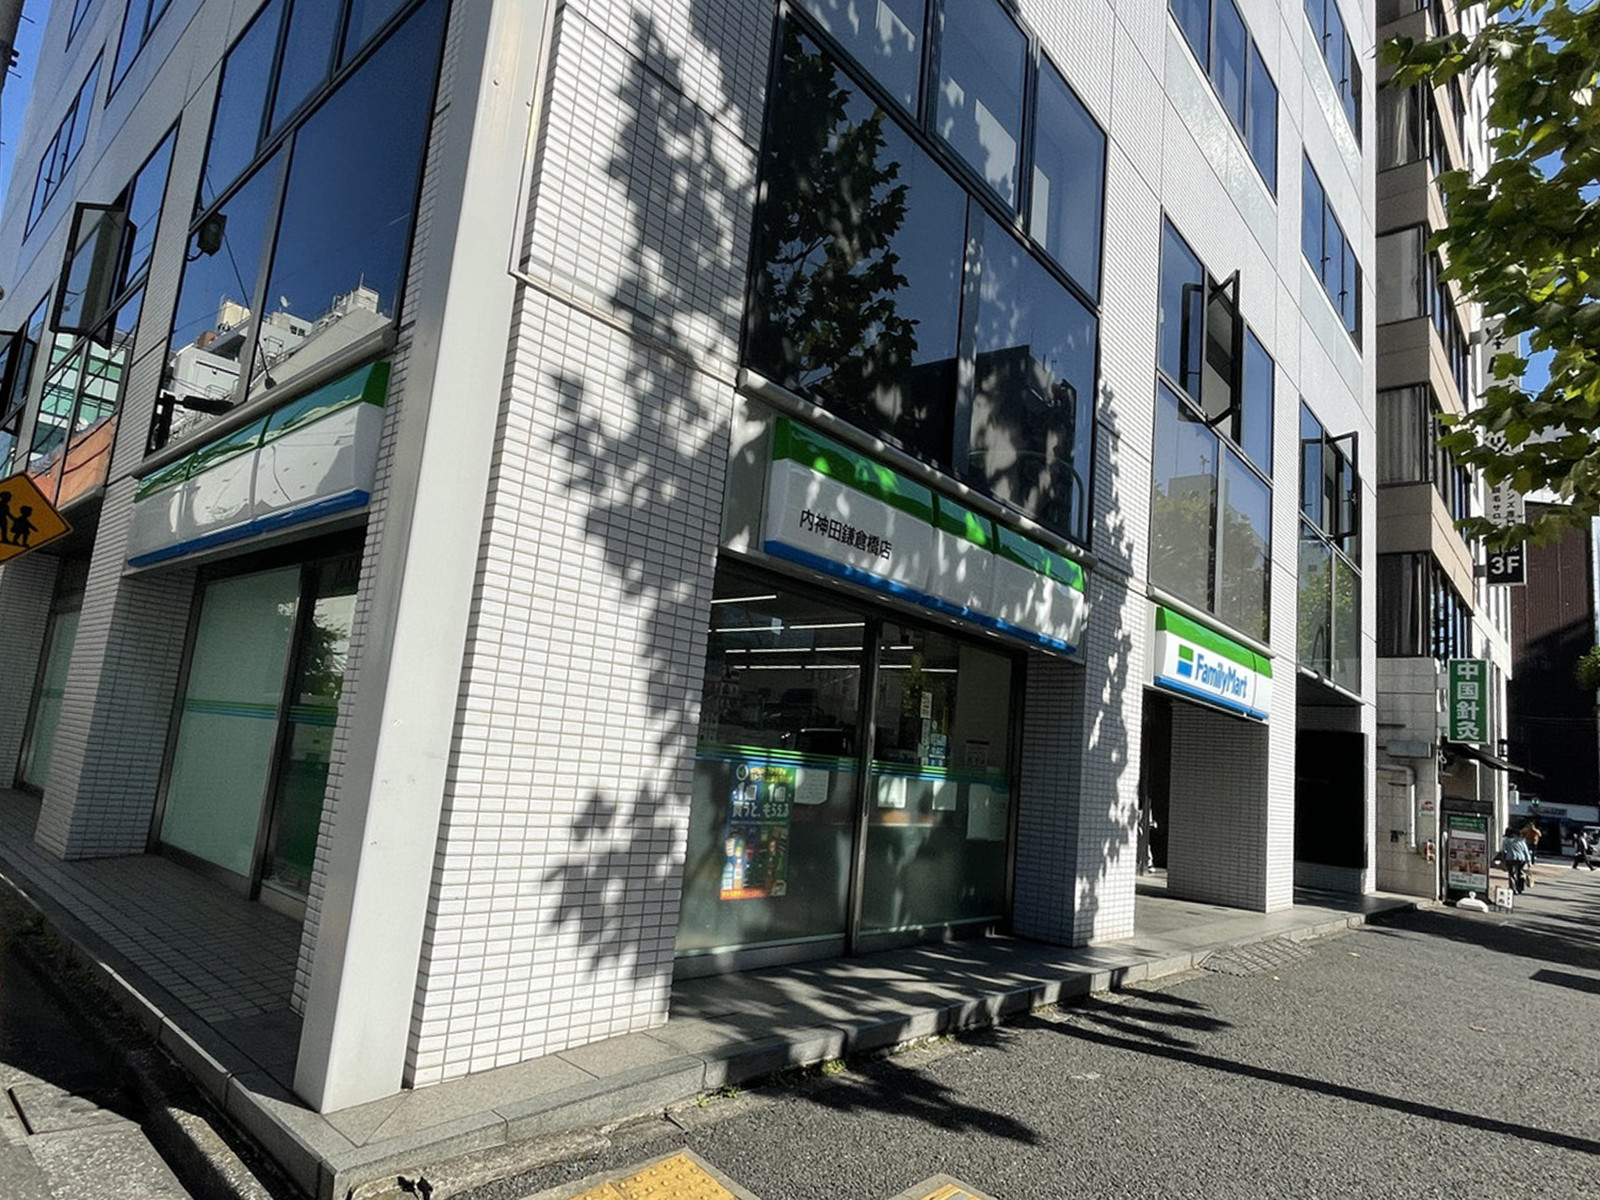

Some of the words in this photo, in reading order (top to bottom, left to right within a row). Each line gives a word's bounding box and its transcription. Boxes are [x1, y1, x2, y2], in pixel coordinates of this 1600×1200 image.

[799, 508, 892, 560] 内神田鎌倉橋店
[1491, 556, 1520, 575] 3F
[1195, 653, 1248, 698] FamilyMart
[1456, 662, 1480, 740] 中国針灸
